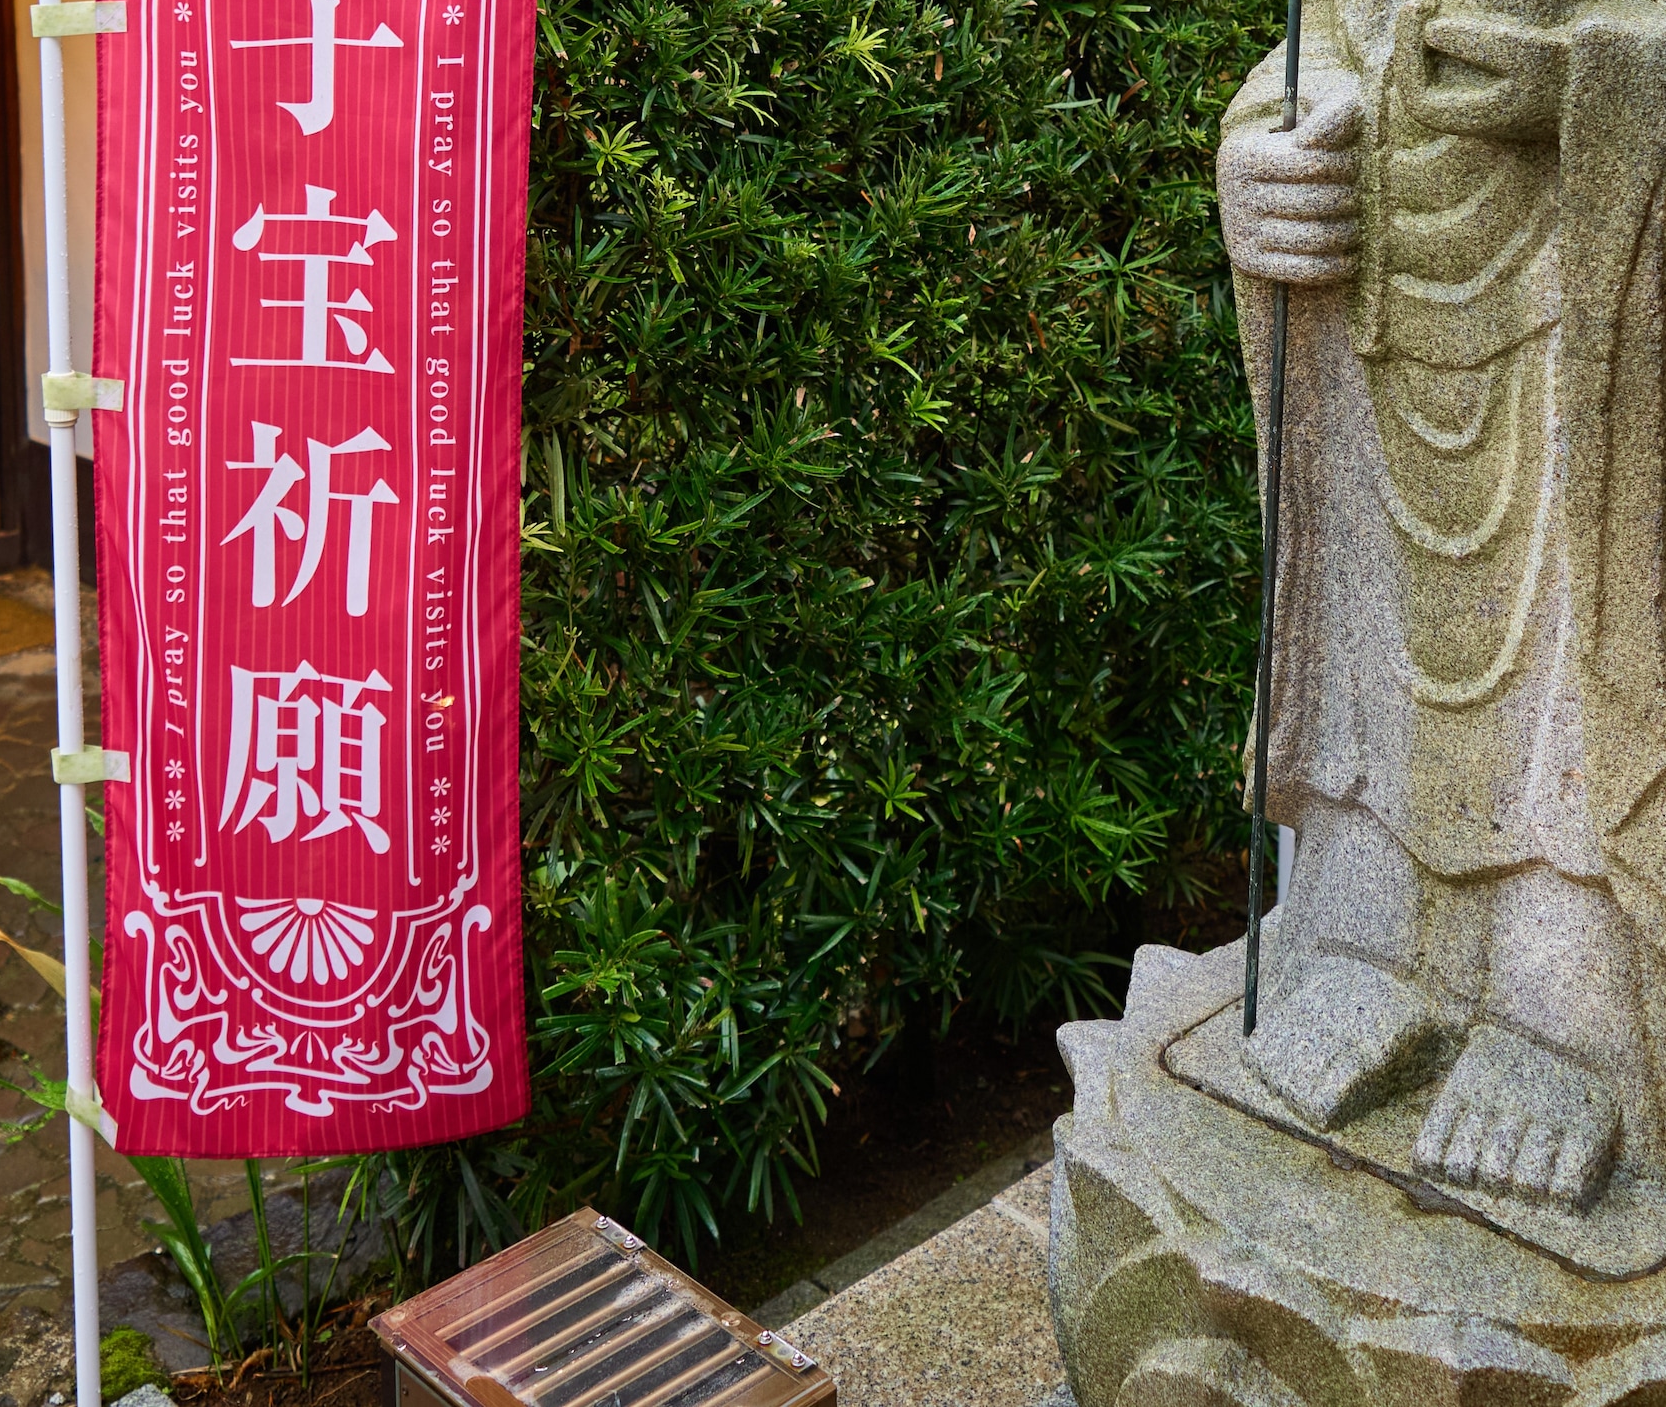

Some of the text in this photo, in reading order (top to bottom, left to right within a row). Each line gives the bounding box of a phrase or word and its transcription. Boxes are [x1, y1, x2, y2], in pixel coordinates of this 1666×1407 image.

[158, 51, 204, 736] I pray so that good luck visits you
[419, 53, 465, 753] I pray so that good luck visits you
